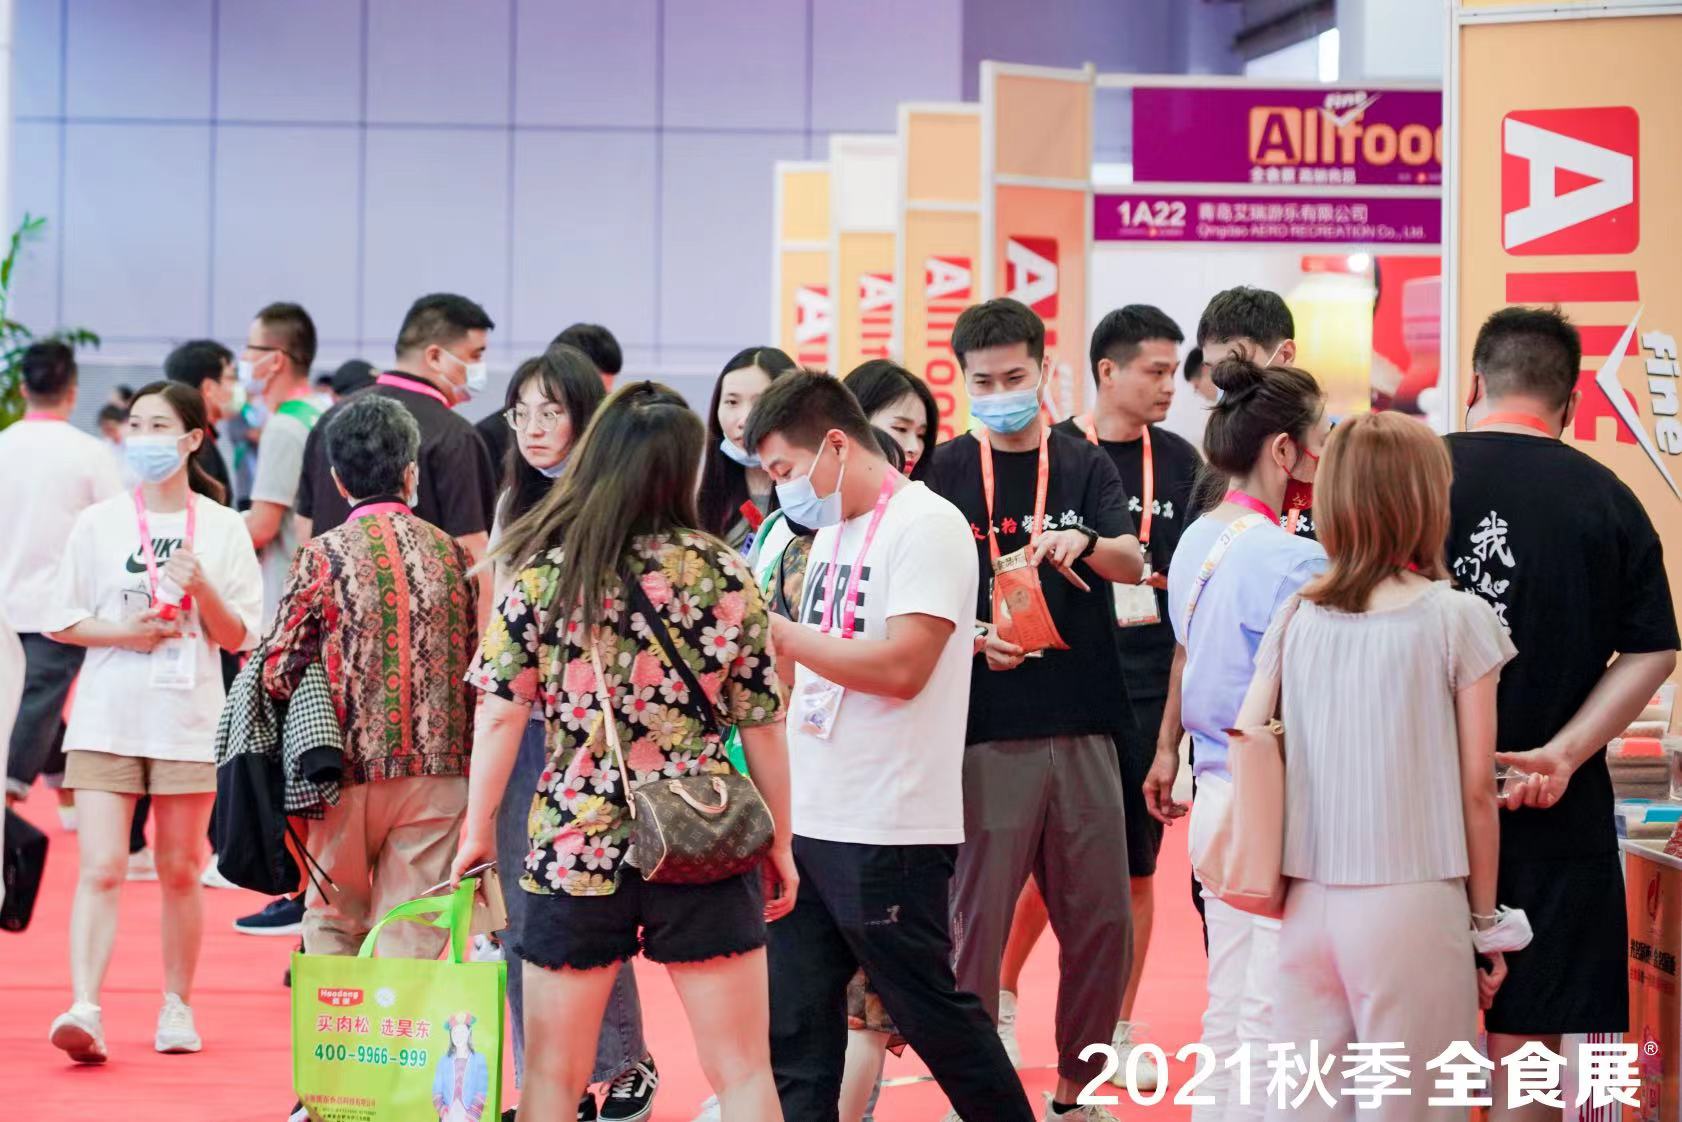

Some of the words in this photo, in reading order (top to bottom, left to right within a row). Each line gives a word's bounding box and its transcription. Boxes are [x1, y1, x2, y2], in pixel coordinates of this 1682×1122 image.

[1117, 200, 1187, 227] 1A22
[1641, 329, 1682, 456] fine
[317, 1015, 369, 1033] 买肉松
[381, 1018, 431, 1039] 选昊东
[314, 1044, 427, 1067] 400-9966-999
